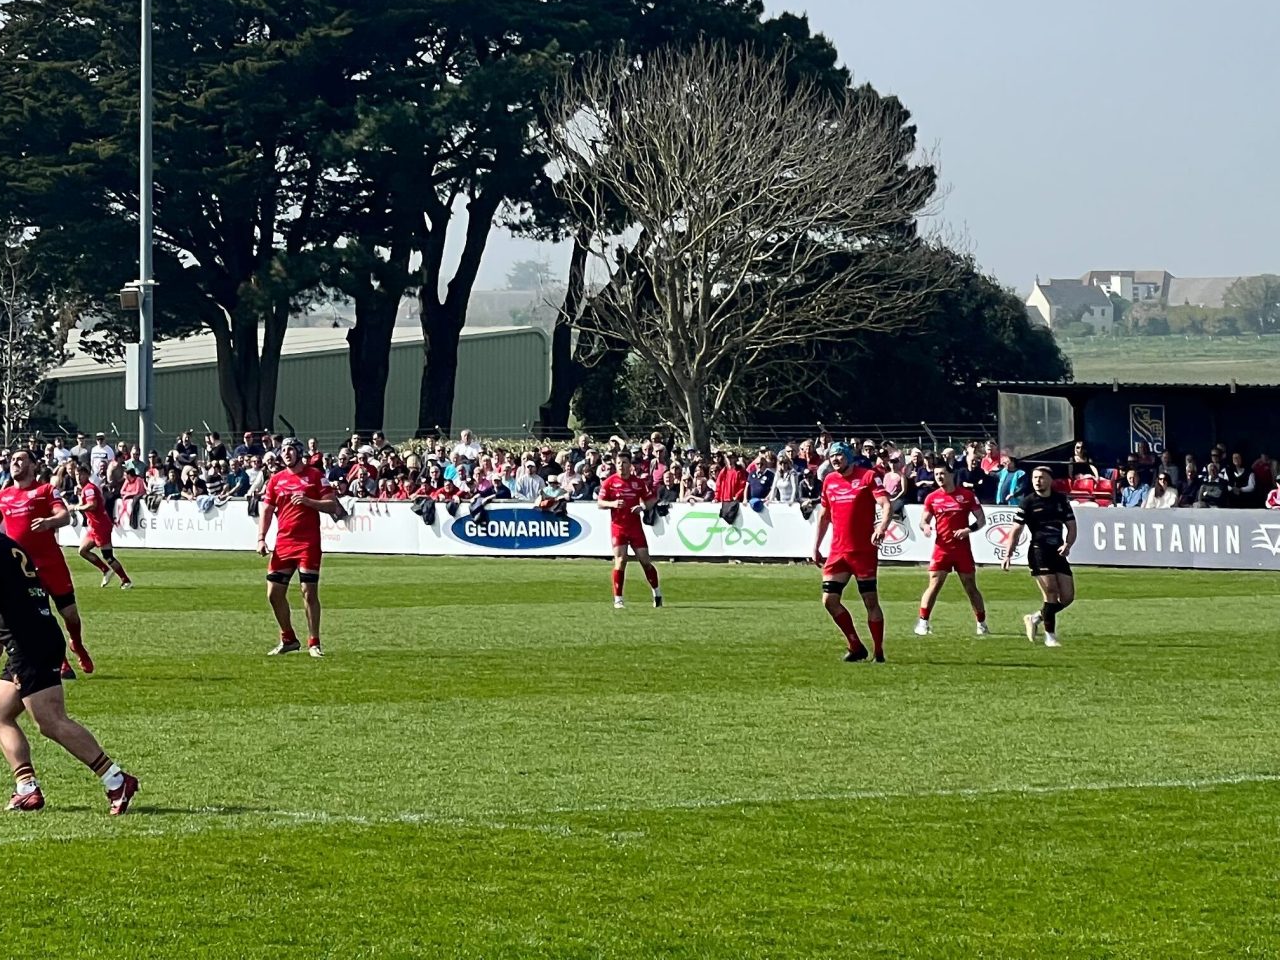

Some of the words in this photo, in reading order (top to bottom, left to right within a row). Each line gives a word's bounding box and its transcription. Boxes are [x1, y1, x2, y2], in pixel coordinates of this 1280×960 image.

[163, 518, 224, 532] WEALTH
[465, 520, 570, 538] GEOMARINE
[677, 511, 768, 552] Fox
[1093, 521, 1241, 554] CENTAMIN
[11, 547, 37, 578] 2
[993, 547, 1020, 559] RES
